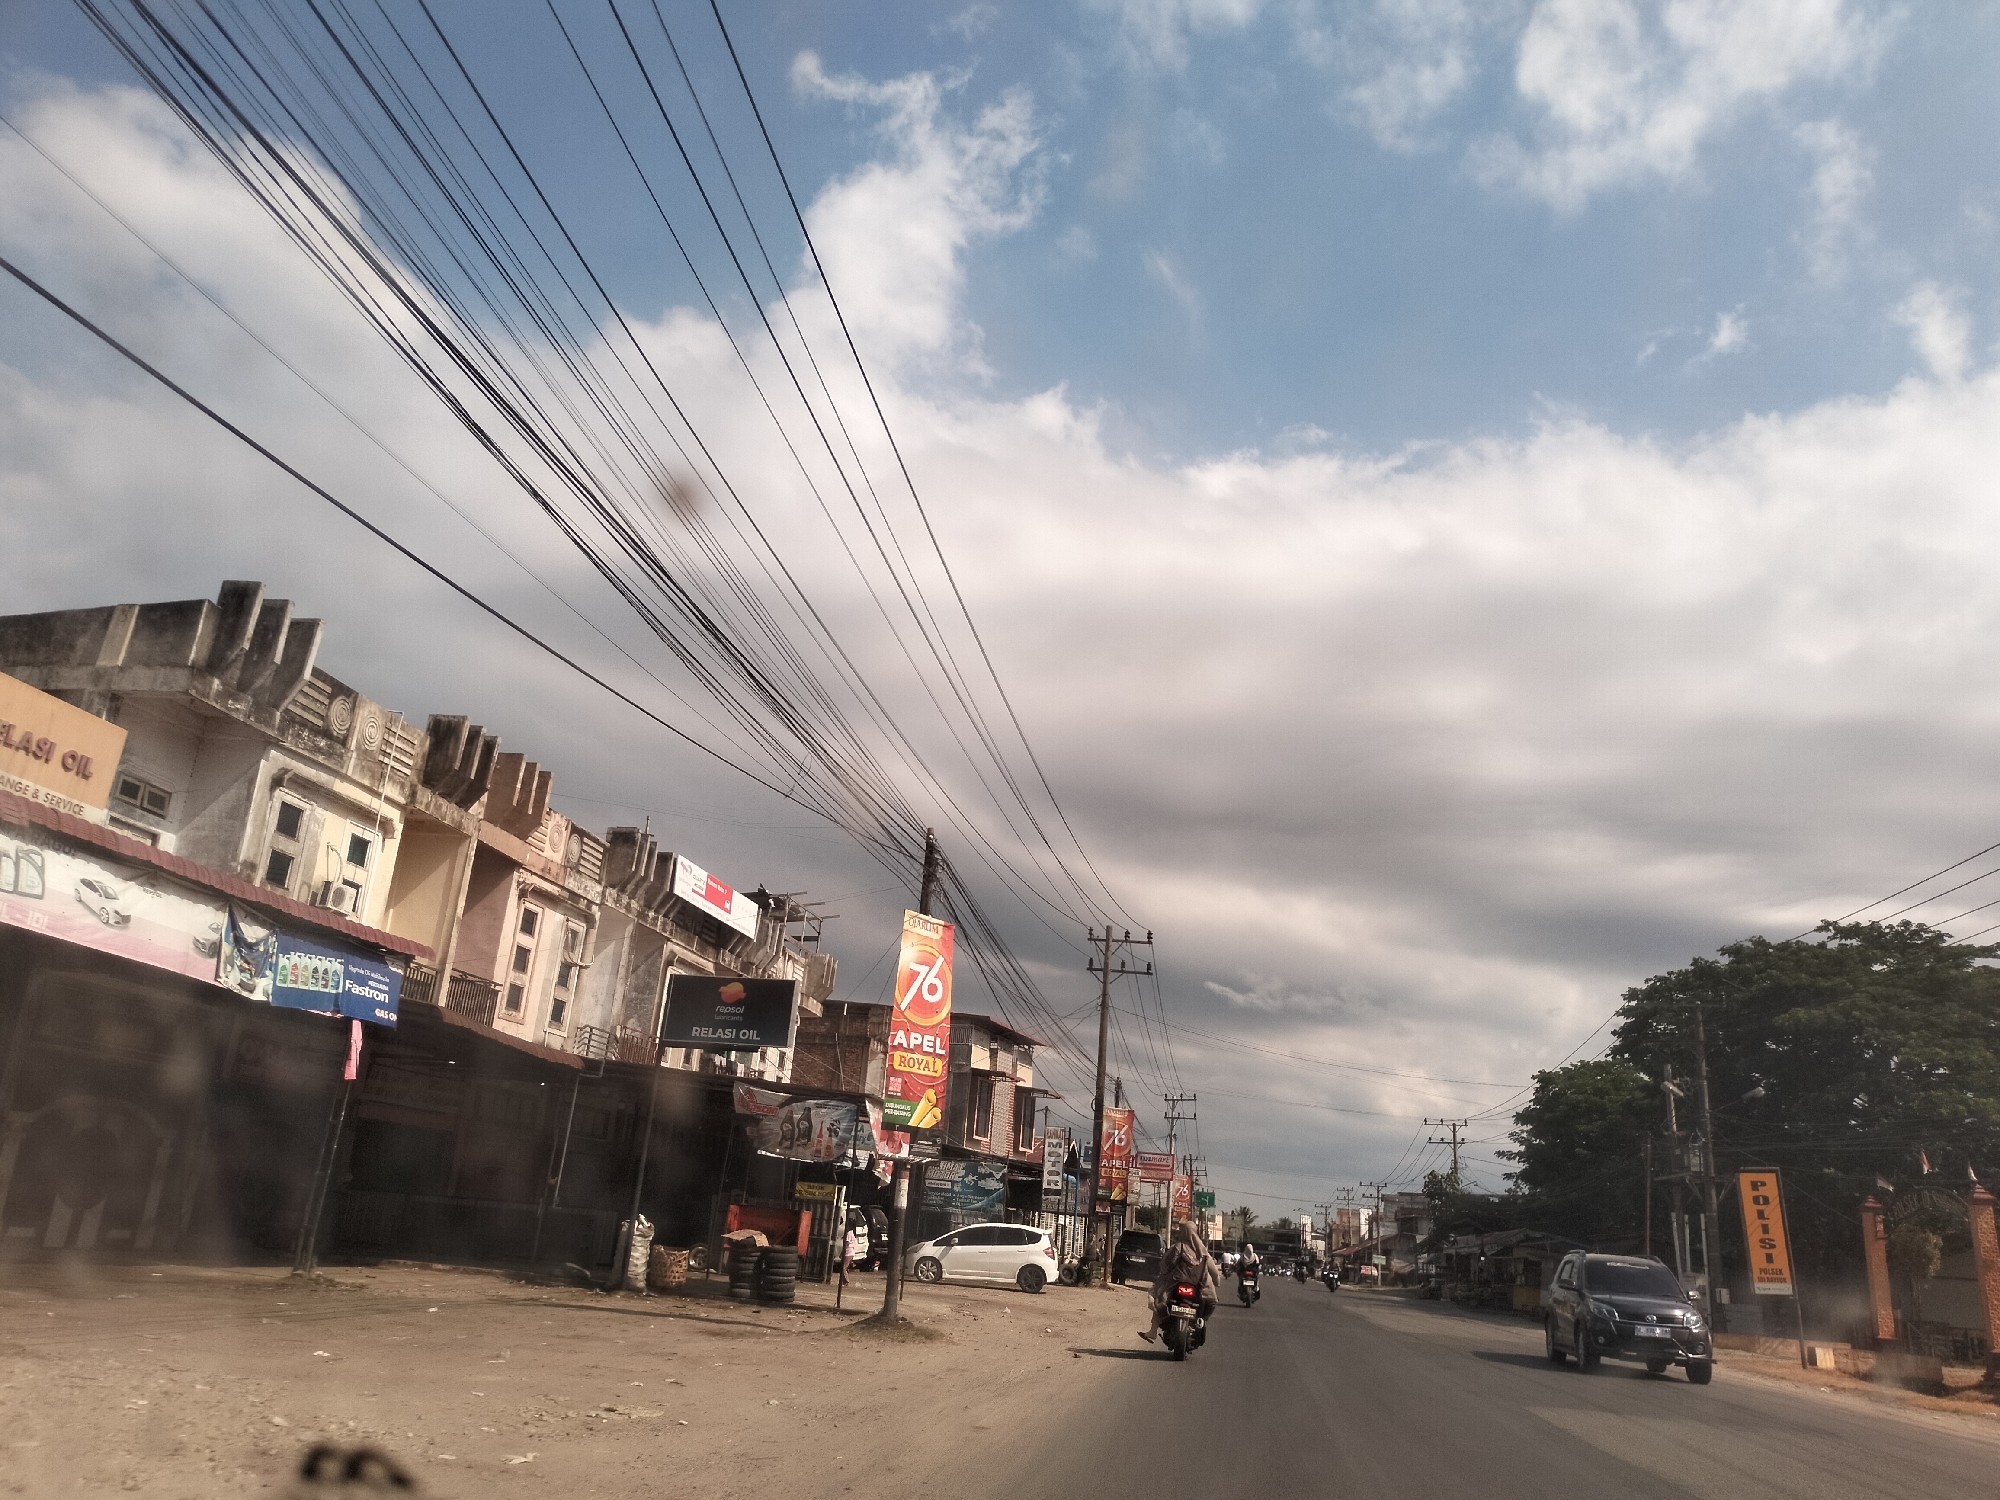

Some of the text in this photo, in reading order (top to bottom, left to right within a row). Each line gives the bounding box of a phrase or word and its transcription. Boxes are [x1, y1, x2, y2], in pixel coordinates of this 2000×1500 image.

[61, 750, 93, 781] OIL
[32, 788, 39, 800] &
[43, 792, 85, 816] SERVICE
[345, 979, 389, 1004] Fastron
[900, 954, 945, 1012] 76
[375, 1008, 389, 1021] GAS
[715, 1005, 745, 1014] repsol
[691, 1026, 761, 1041] RELASI OIL
[893, 1029, 946, 1055] APEL
[898, 1054, 939, 1073] ROYAL
[1103, 1124, 1129, 1151] 76
[1046, 1141, 1062, 1187] MOTOR
[1101, 1158, 1128, 1169] APEL
[1175, 1184, 1189, 1198] 76
[1750, 1180, 1777, 1264] POLISI
[1759, 1267, 1784, 1276] POLSEK
